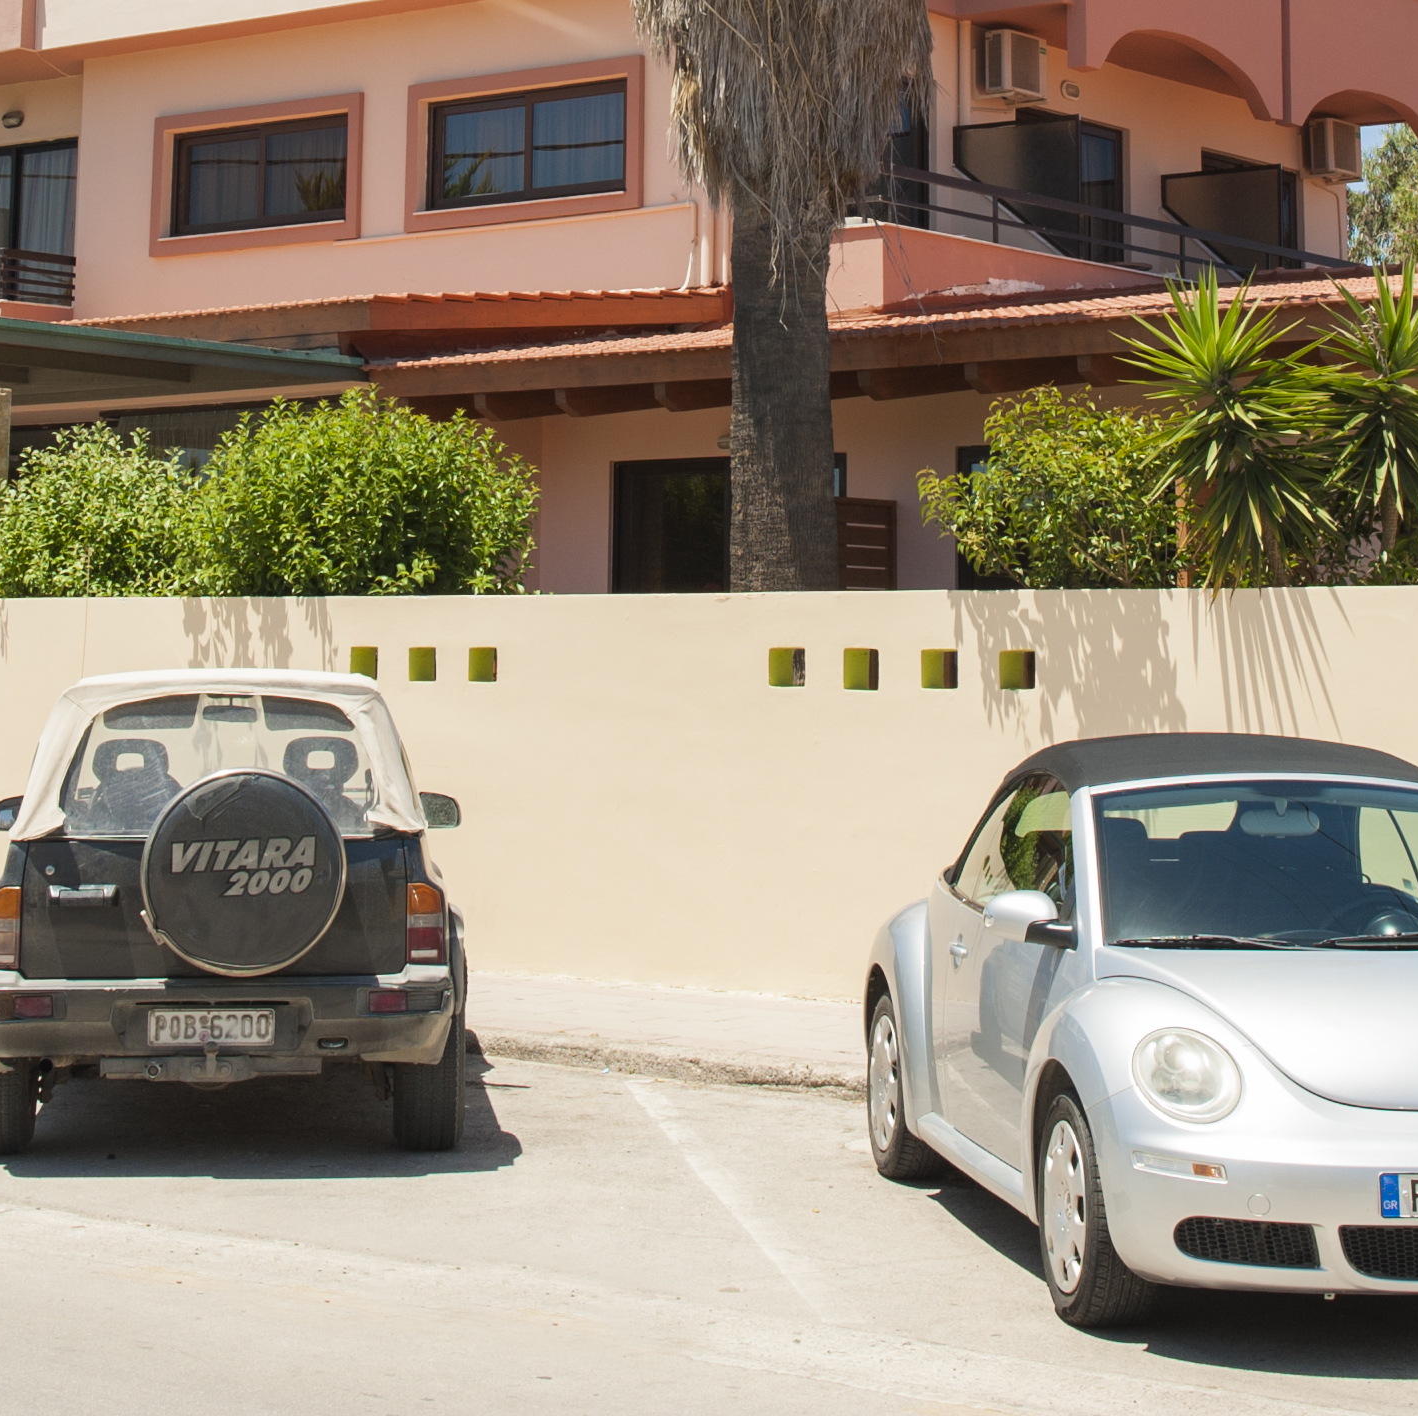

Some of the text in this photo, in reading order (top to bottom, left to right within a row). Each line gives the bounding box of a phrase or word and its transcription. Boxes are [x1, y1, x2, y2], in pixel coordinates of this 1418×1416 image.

[171, 835, 316, 874] VITARA
[222, 867, 313, 897] 2000
[1383, 1199, 1398, 1210] GR
